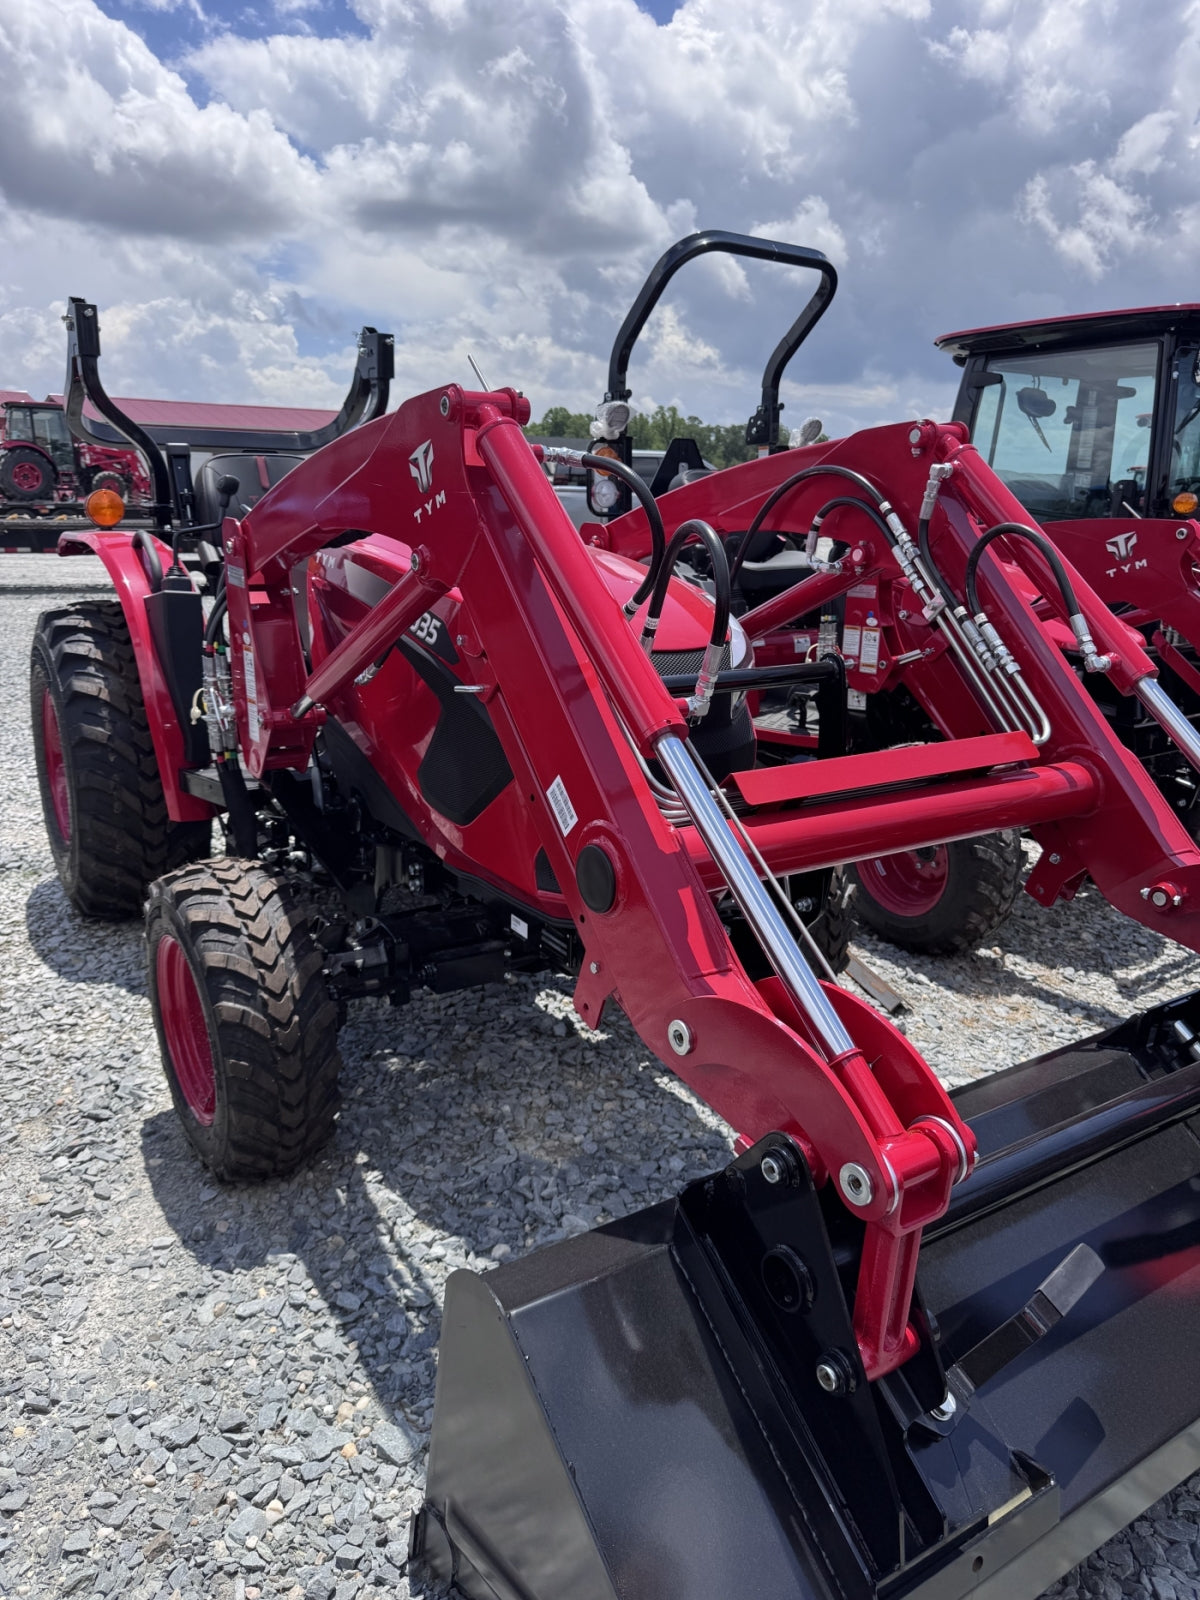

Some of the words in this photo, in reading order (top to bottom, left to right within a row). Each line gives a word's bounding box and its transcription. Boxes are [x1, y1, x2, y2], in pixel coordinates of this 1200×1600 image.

[413, 489, 447, 524] TYM
[315, 551, 337, 569] TYM
[1105, 558, 1148, 578] TYM
